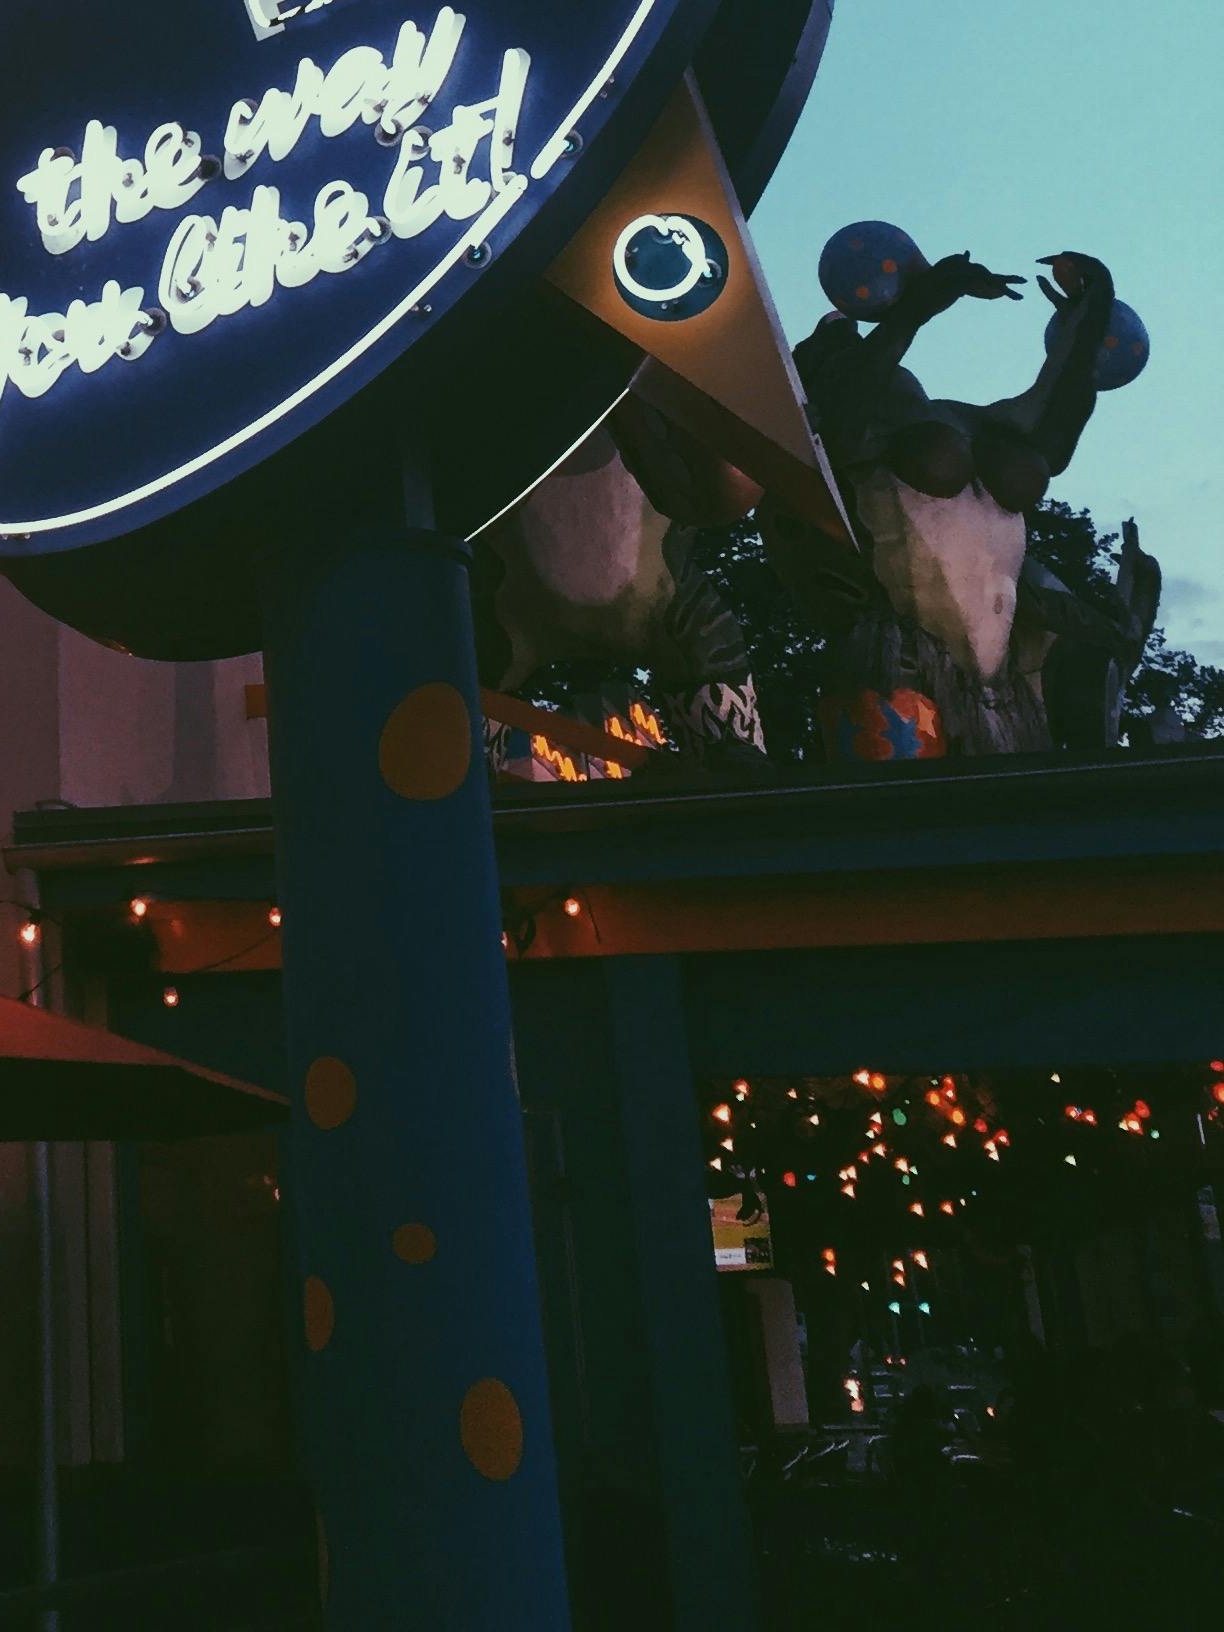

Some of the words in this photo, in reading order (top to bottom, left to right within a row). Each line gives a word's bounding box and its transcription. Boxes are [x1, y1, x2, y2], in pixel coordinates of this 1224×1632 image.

[16, 119, 204, 255] the
[223, 5, 467, 180] way
[158, 180, 382, 334] like
